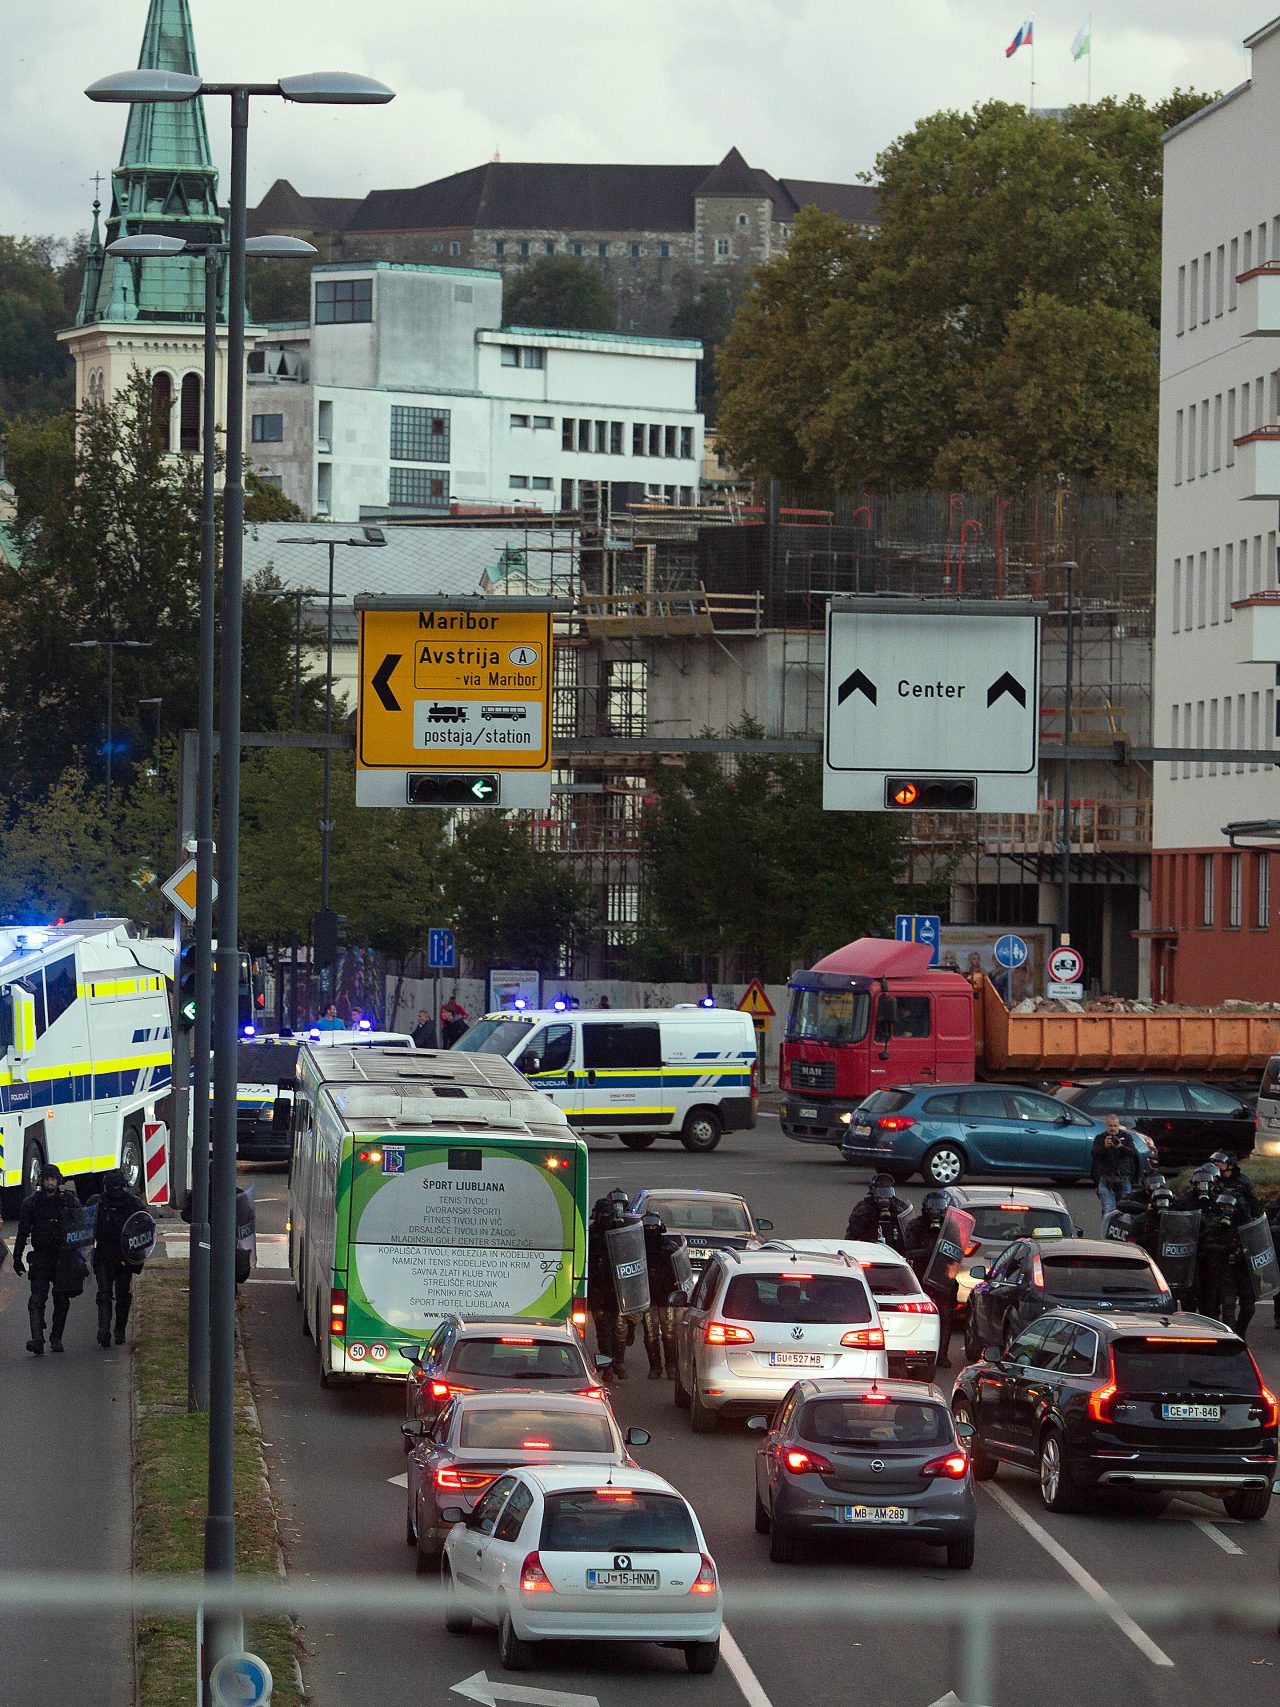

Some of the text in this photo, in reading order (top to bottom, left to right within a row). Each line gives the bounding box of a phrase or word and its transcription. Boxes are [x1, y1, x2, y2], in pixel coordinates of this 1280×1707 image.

[419, 612, 499, 629] Maribor
[419, 647, 499, 669] Avstrija
[519, 650, 527, 663] A
[489, 672, 537, 686] Maribor
[898, 680, 965, 698] Center
[424, 727, 531, 746] postaja/station
[802, 1066, 822, 1076] MAN
[422, 1178, 505, 1192] ŠPORT LJUBLJANA
[439, 1196, 488, 1205] TENIS TIVOLI
[425, 1205, 501, 1216] DVORANSKI ŠPORTI
[423, 1215, 503, 1226] FITNES TIVOLI IN VIČ
[409, 1224, 516, 1237] DRSALIŠČE TIVOLI IN ZALOG
[129, 1230, 152, 1249] POLICIJA
[391, 1235, 434, 1243] MLADINSKI
[436, 1236, 456, 1244] GOLF
[458, 1237, 489, 1246] CENTER
[378, 1245, 545, 1260] KOPALIŠČA TIVOLI, KOLEZIJA IN KODELJEVO
[392, 1257, 531, 1269] NAMIZNI TENIS KODELJEVO IN KRIM
[412, 1267, 510, 1278] SAVNA ZLATI KLUB TIVOLI
[423, 1276, 498, 1288] STRELIŠČE RUDNIK
[428, 1288, 493, 1298] PIKNIKI RIC SAVA
[410, 1297, 510, 1309] ŠPORT HOTEL LJUBLJANA
[353, 1346, 364, 1356] 50
[374, 1347, 385, 1357] 70
[777, 1354, 821, 1364] GU 527 MB
[1170, 1407, 1218, 1417] CE PT-846
[854, 1508, 904, 1519] MB AM-289
[597, 1573, 655, 1585] LJ 15-HNM
